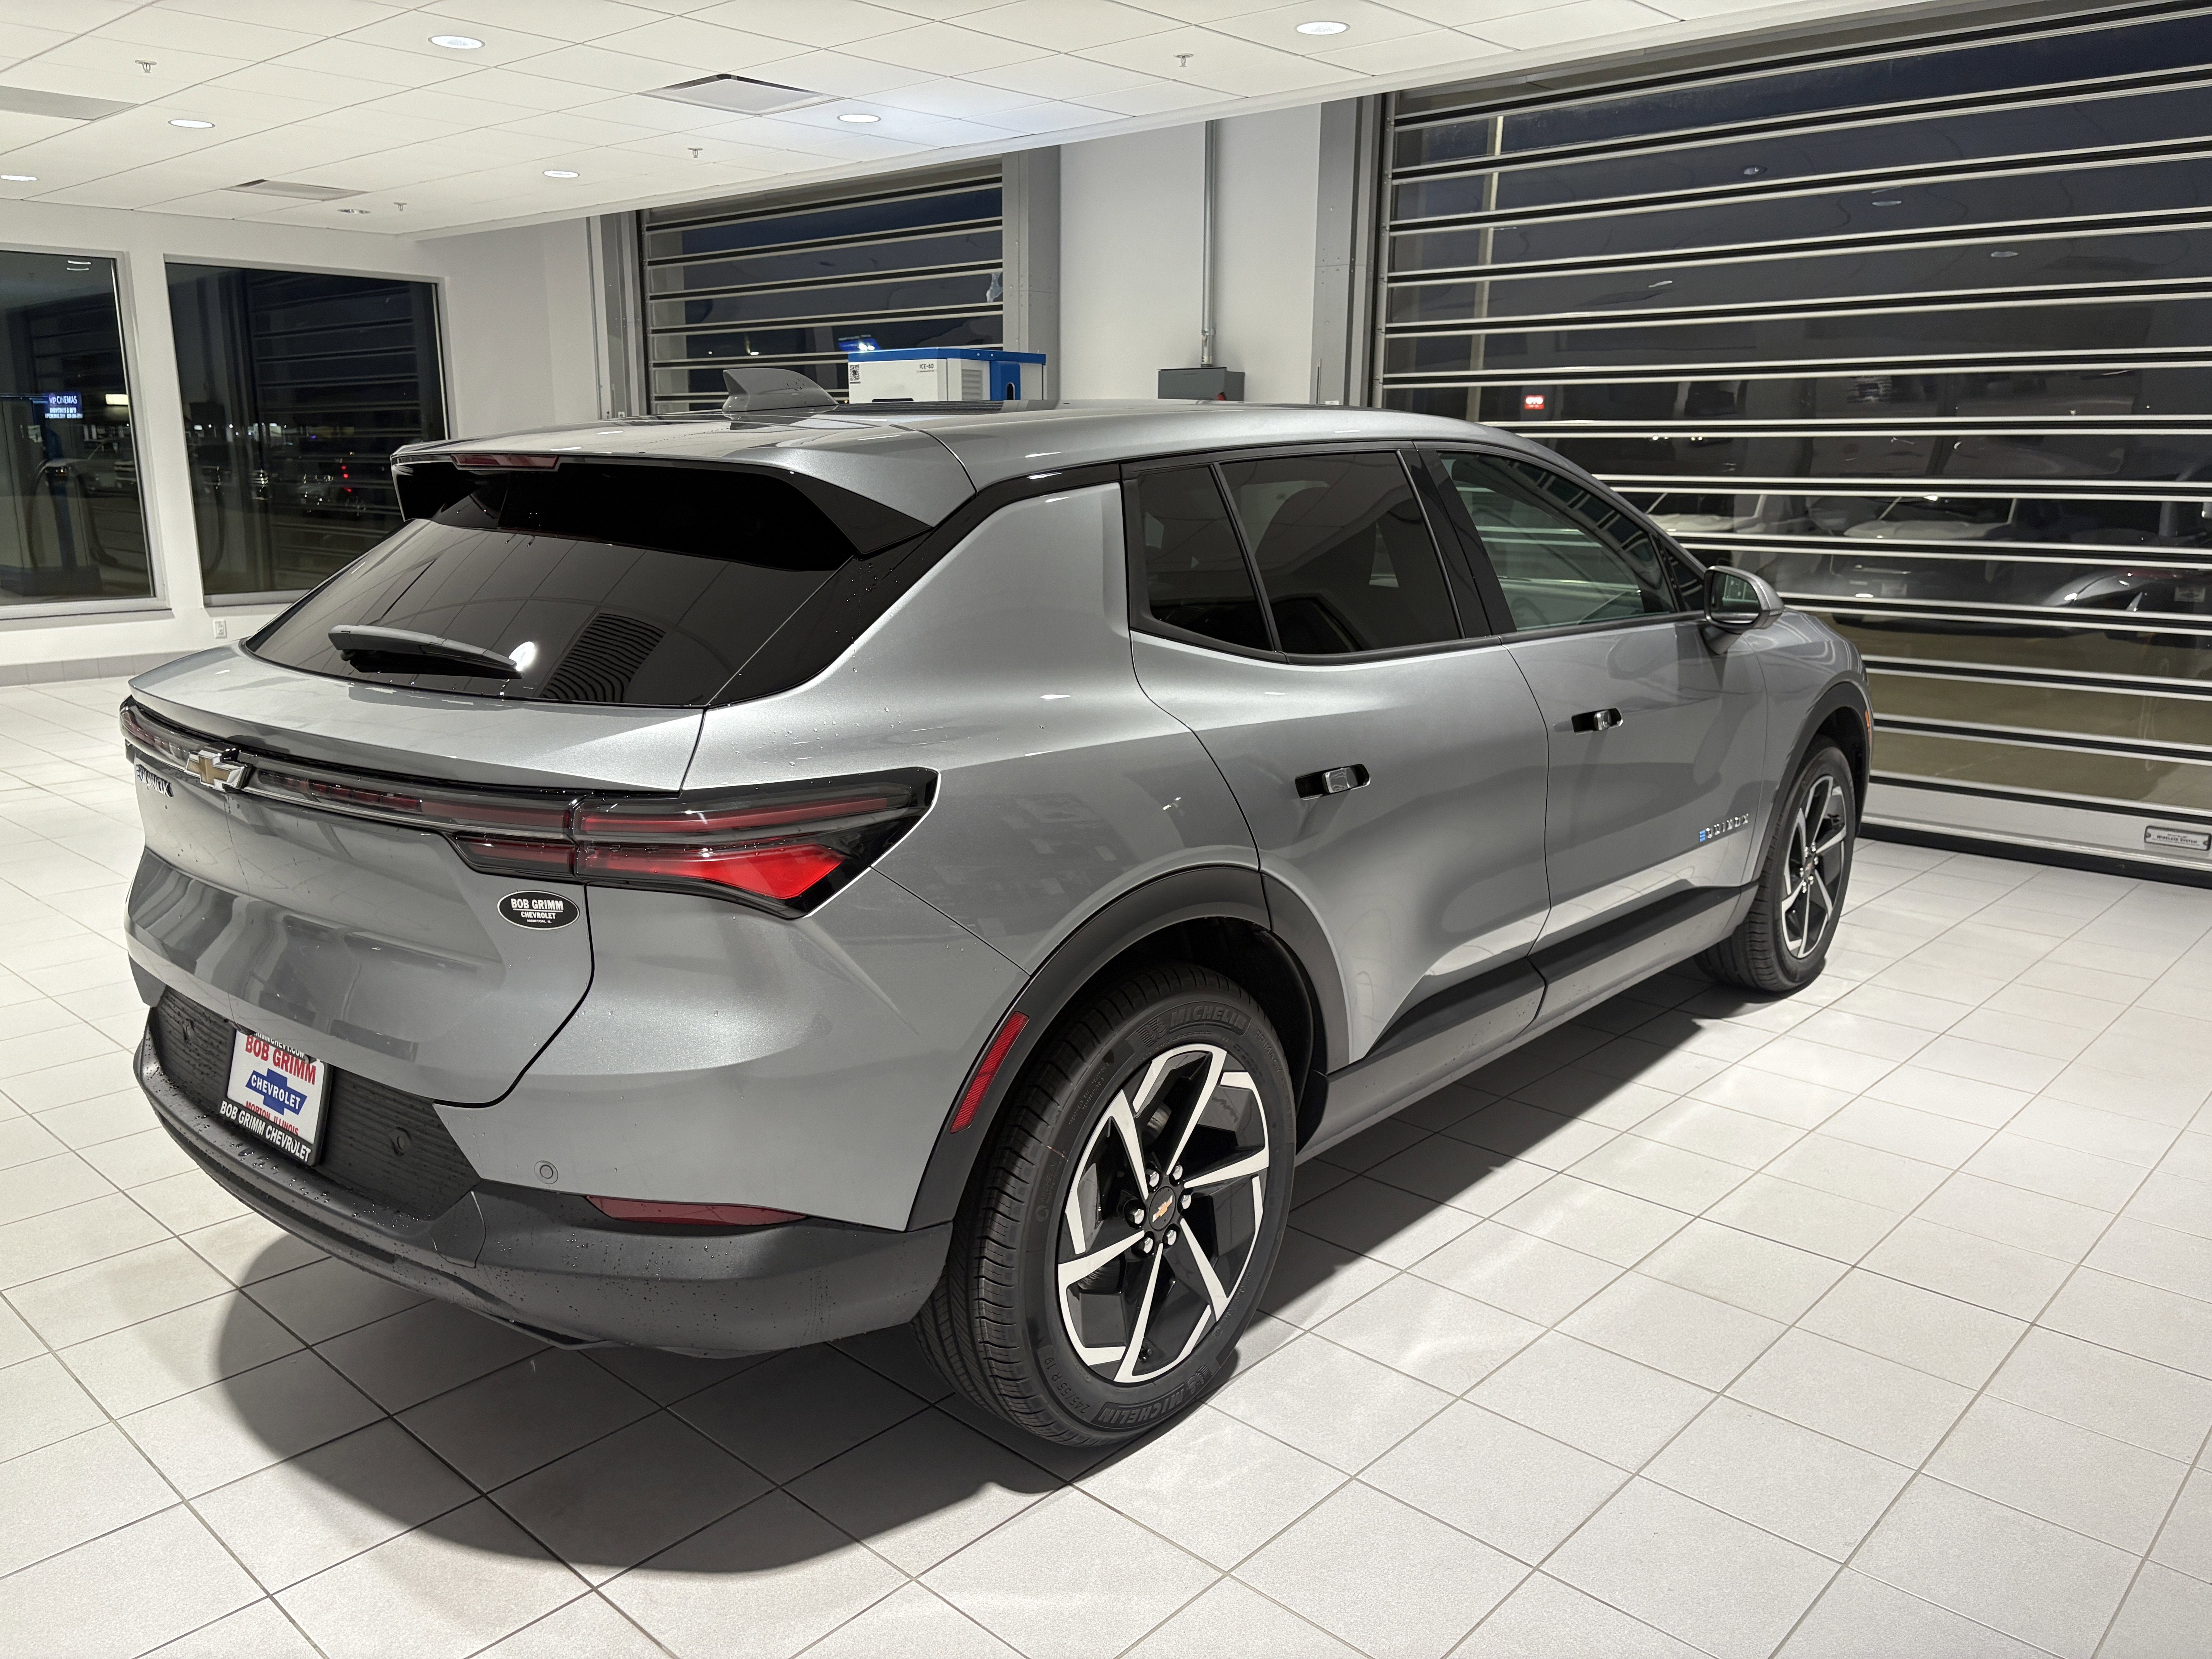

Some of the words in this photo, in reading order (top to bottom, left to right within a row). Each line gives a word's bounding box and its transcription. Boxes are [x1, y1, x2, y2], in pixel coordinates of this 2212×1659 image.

[511, 898, 529, 909] BOB
[531, 899, 564, 910] GRIMM
[520, 911, 556, 919] CHEVROLET
[1170, 1005, 1247, 1030] MICHELIN
[245, 1035, 270, 1062] BOB
[273, 1048, 316, 1085] GRIMM
[251, 1074, 301, 1110] CHEVROLET
[220, 1100, 237, 1120] BOB
[238, 1110, 266, 1135] GRIMM
[266, 1125, 311, 1162] CHEVROLET
[1044, 1357, 1056, 1370] 19
[1051, 1371, 1063, 1382] R
[1056, 1382, 1091, 1413] 245/55
[1097, 1388, 1185, 1424] MICHELIN
